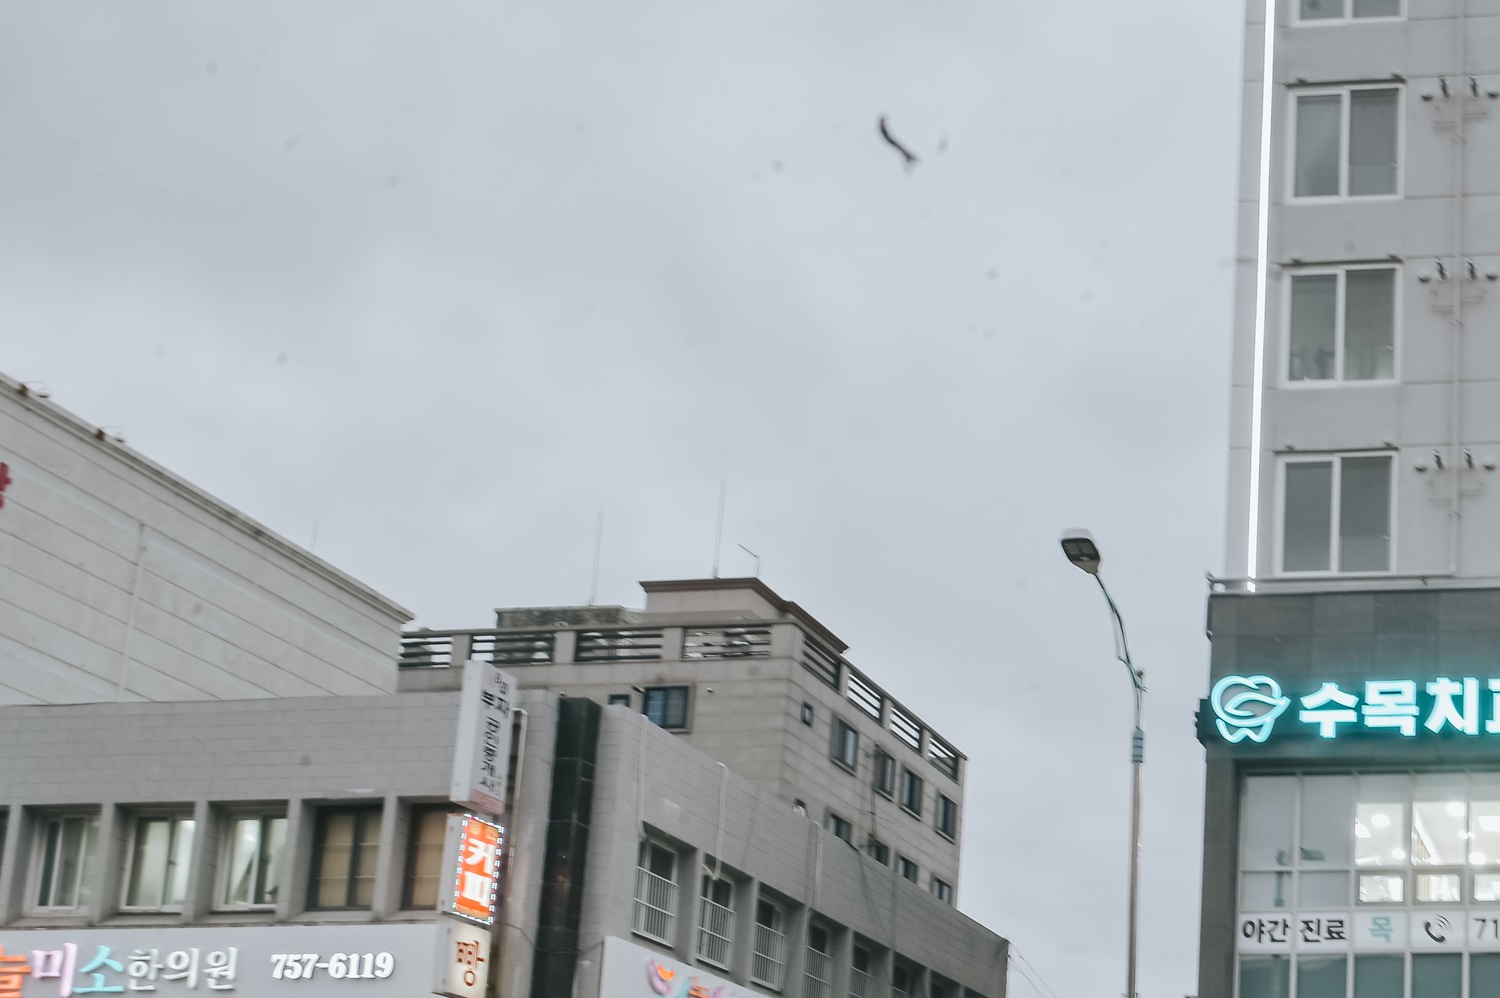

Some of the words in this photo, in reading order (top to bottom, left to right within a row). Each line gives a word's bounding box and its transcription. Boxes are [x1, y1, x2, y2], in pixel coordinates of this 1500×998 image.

[464, 838, 492, 907] 커피
[1241, 916, 1291, 943] 야간
[1299, 917, 1348, 942] 진료
[1367, 916, 1394, 944] 목
[270, 951, 396, 982] 757-6119
[456, 939, 485, 987] 빵
